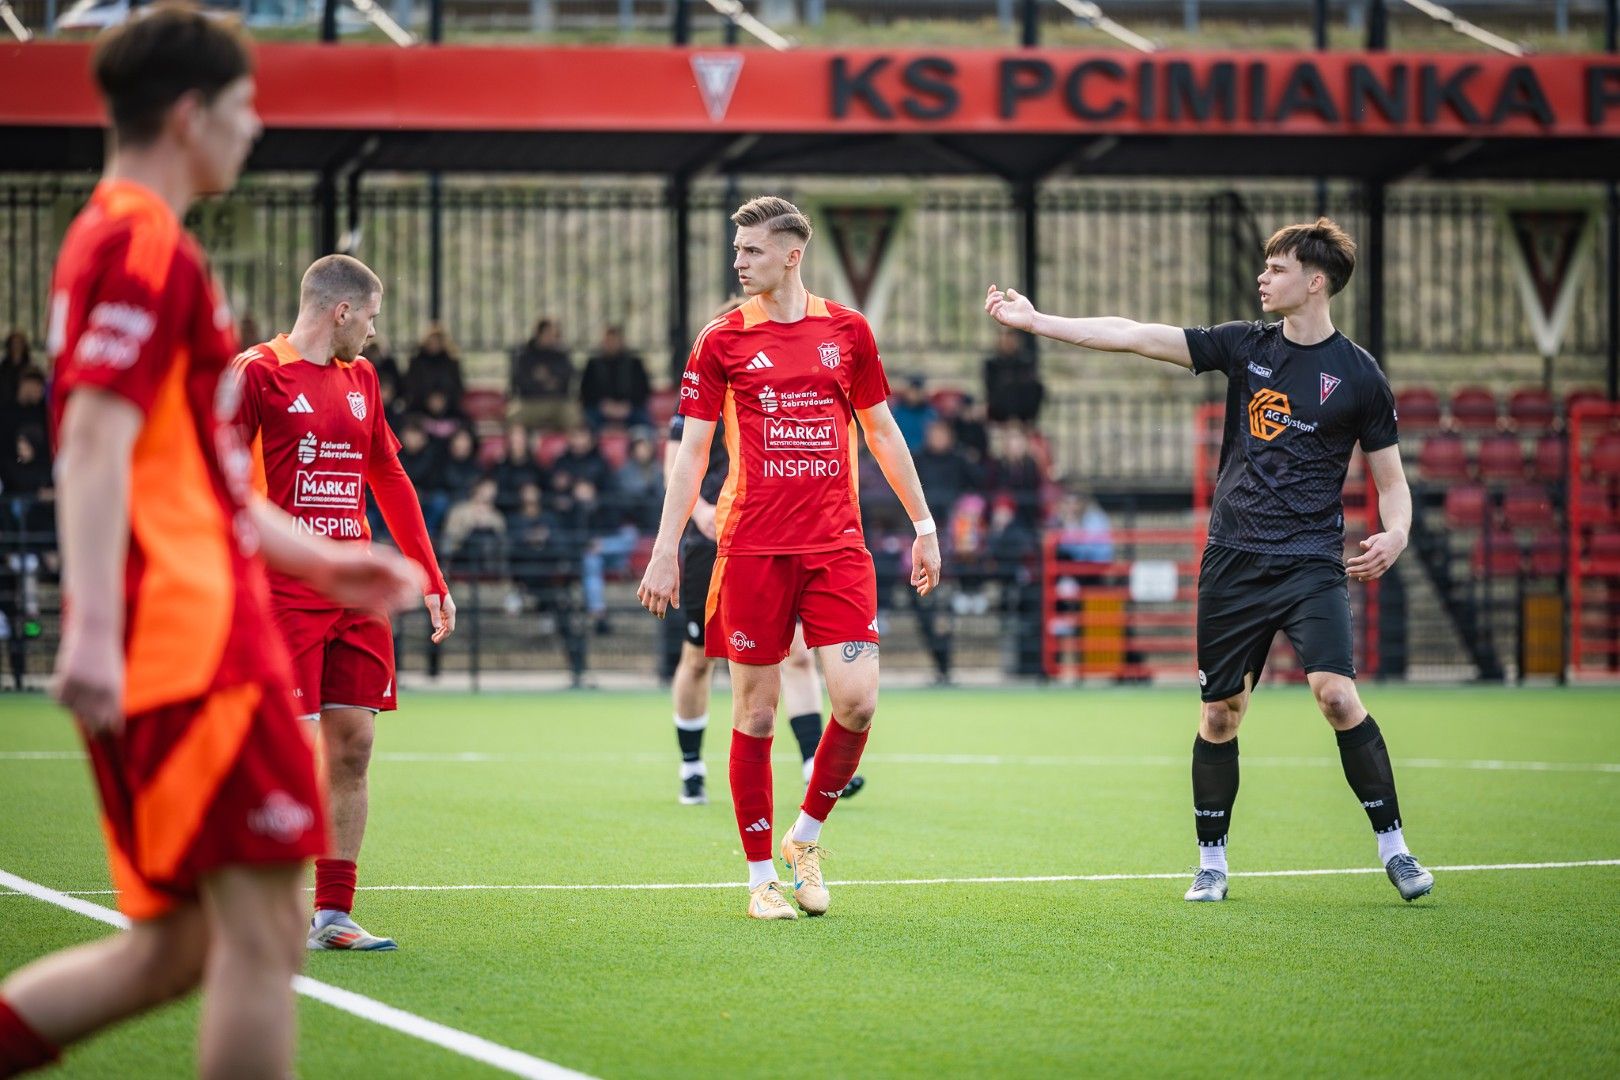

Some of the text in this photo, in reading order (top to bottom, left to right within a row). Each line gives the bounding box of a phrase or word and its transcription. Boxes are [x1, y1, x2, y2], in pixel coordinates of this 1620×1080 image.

[830, 56, 961, 121] KS
[997, 57, 1557, 126] PCIMIANKA
[780, 390, 818, 400] Kalwaria
[1265, 409, 1315, 433] AG System
[769, 426, 832, 440] MARKAT
[320, 441, 351, 450] Kalwaria
[764, 459, 840, 478] INSPIRO
[301, 480, 358, 497] MARKAT
[291, 516, 362, 538] INSPIRO
